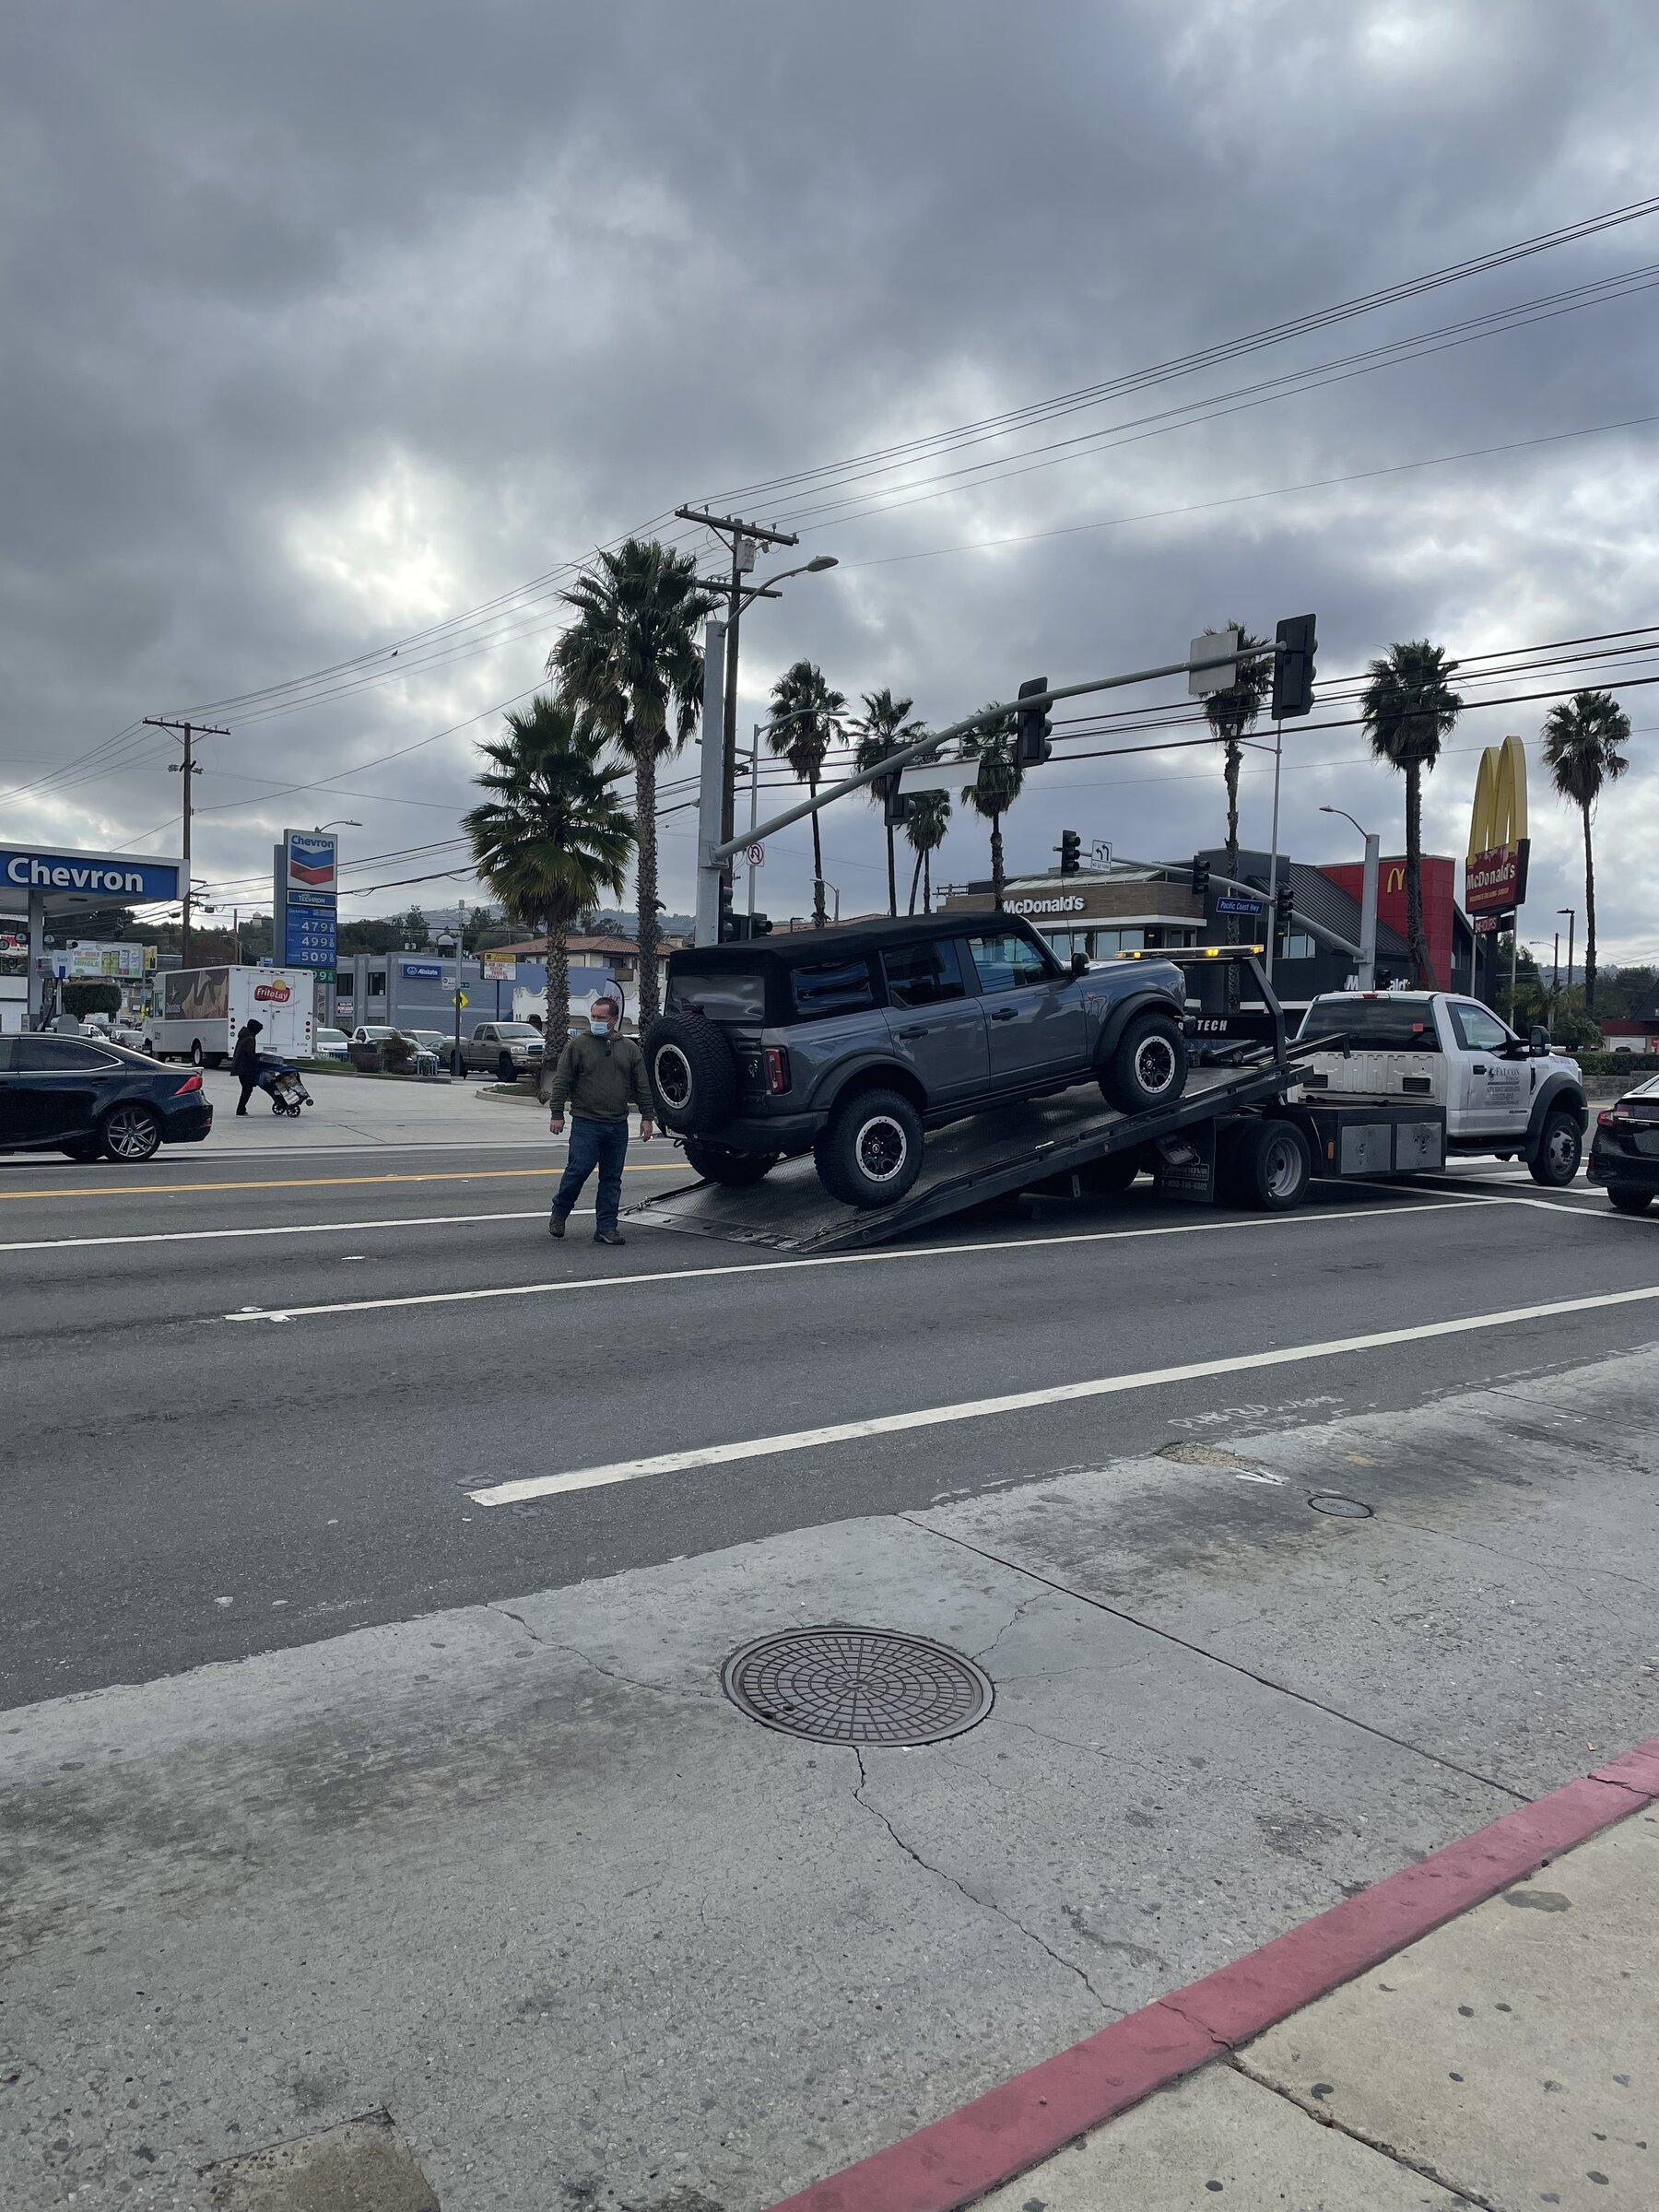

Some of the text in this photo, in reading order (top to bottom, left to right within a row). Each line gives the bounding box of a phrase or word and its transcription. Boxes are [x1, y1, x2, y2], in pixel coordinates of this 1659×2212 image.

[291, 835, 334, 848] Chevron
[7, 857, 143, 892] Chevron
[1466, 863, 1515, 890] McDonald's
[1003, 895, 1085, 914] McDonald's
[1220, 900, 1260, 913] Pacific Coast Hwy
[1496, 1067, 1519, 1077] FALCON
